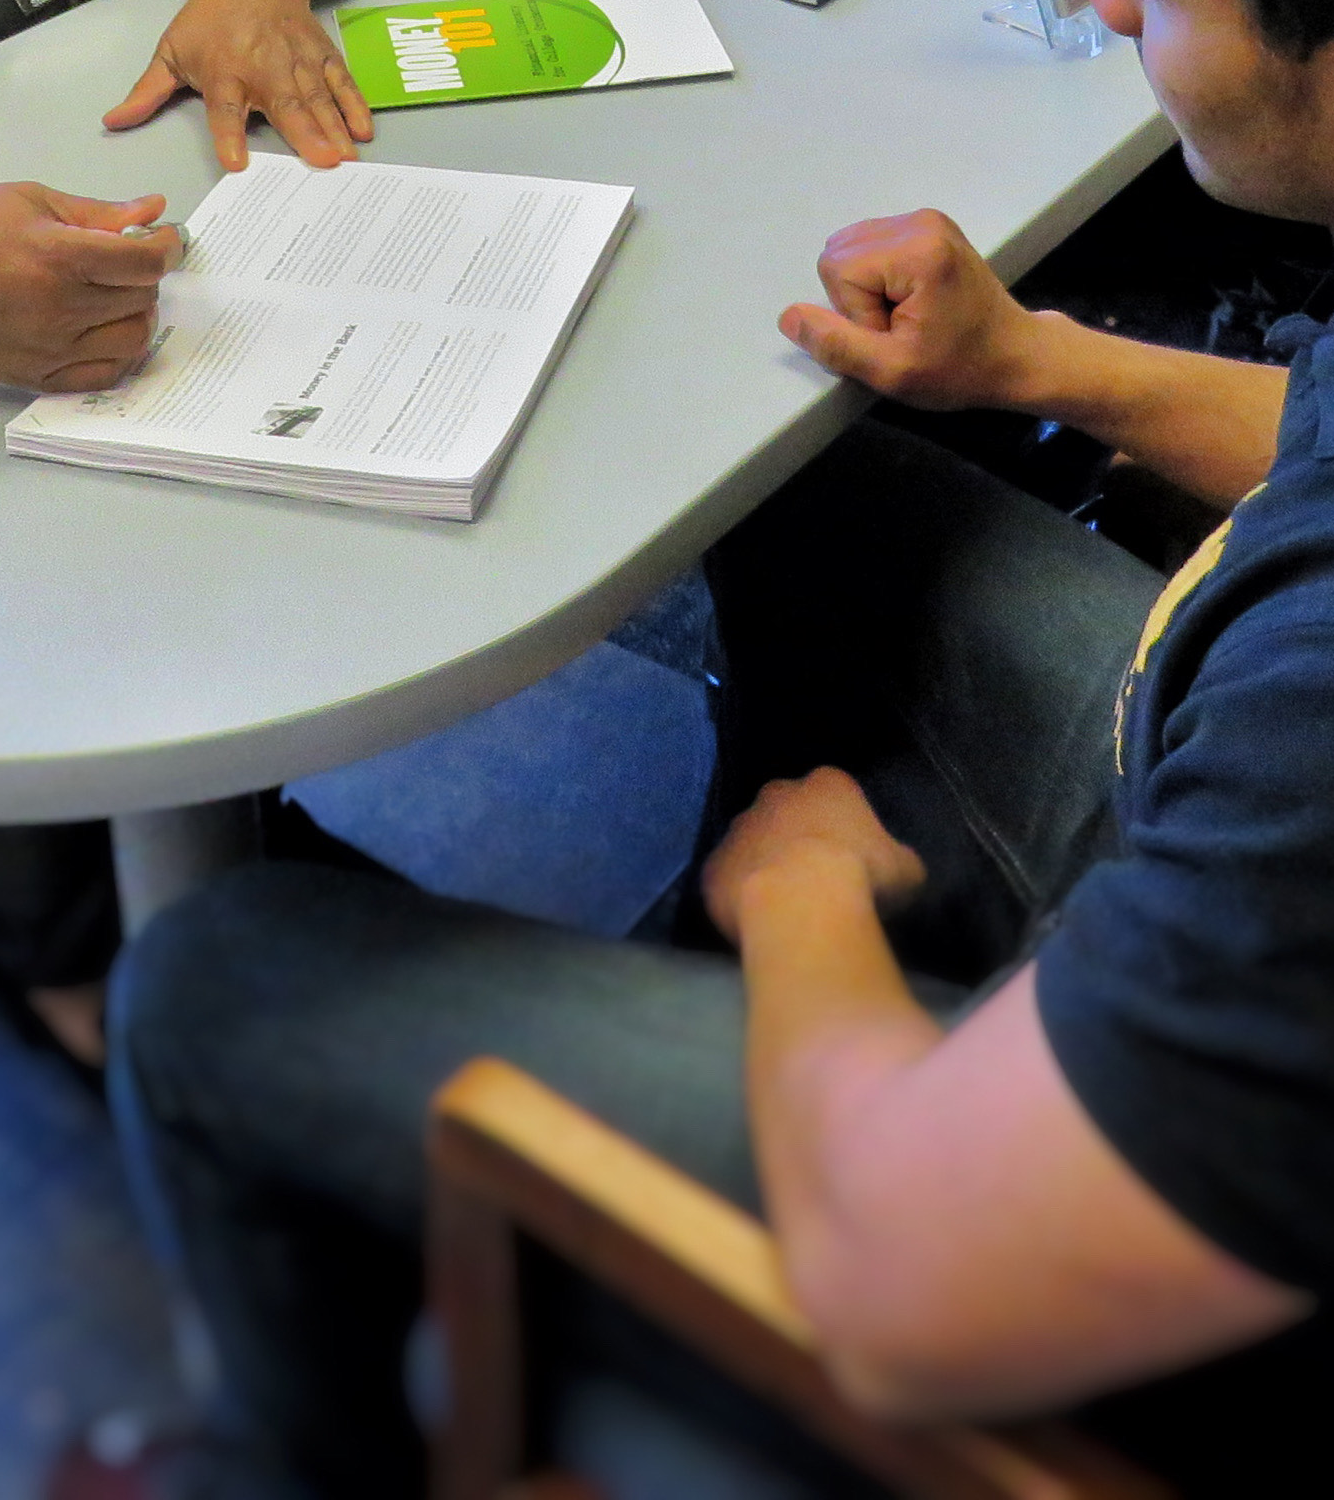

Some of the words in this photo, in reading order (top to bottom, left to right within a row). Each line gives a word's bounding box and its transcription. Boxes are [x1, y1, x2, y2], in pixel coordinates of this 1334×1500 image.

[385, 17, 465, 93] MONEY
[433, 8, 497, 53] 101
[298, 371, 329, 400] Money
[325, 346, 344, 361] the
[335, 323, 358, 346] Bank
